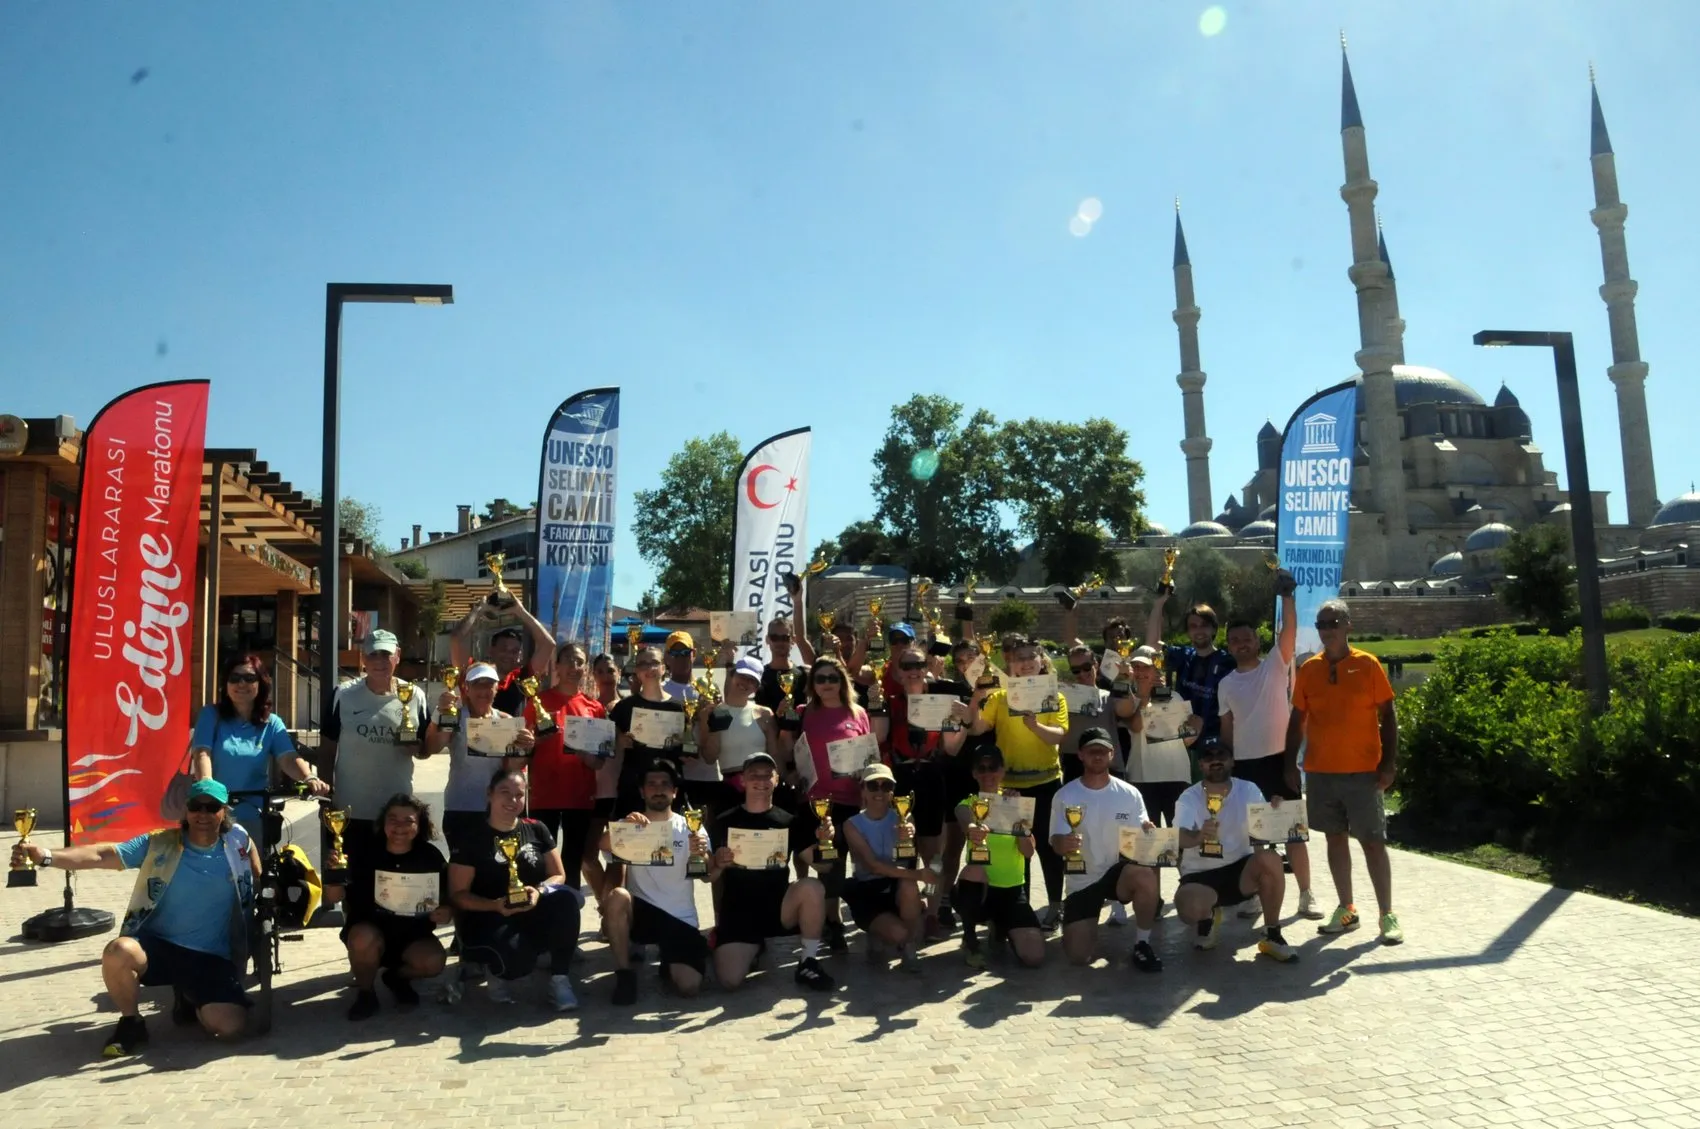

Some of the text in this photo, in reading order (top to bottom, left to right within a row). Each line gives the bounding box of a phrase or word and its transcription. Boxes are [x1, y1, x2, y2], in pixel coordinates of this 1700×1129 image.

[548, 440, 614, 469] UNESCO
[1284, 458, 1351, 488] UNESCO
[1285, 487, 1349, 512] SELİMİYE
[1295, 512, 1337, 536] CAMİİ
[94, 437, 126, 660] ULUSLARARASI
[546, 544, 609, 570] KOŞUSU
[116, 400, 189, 747] Edirne Maratonu
